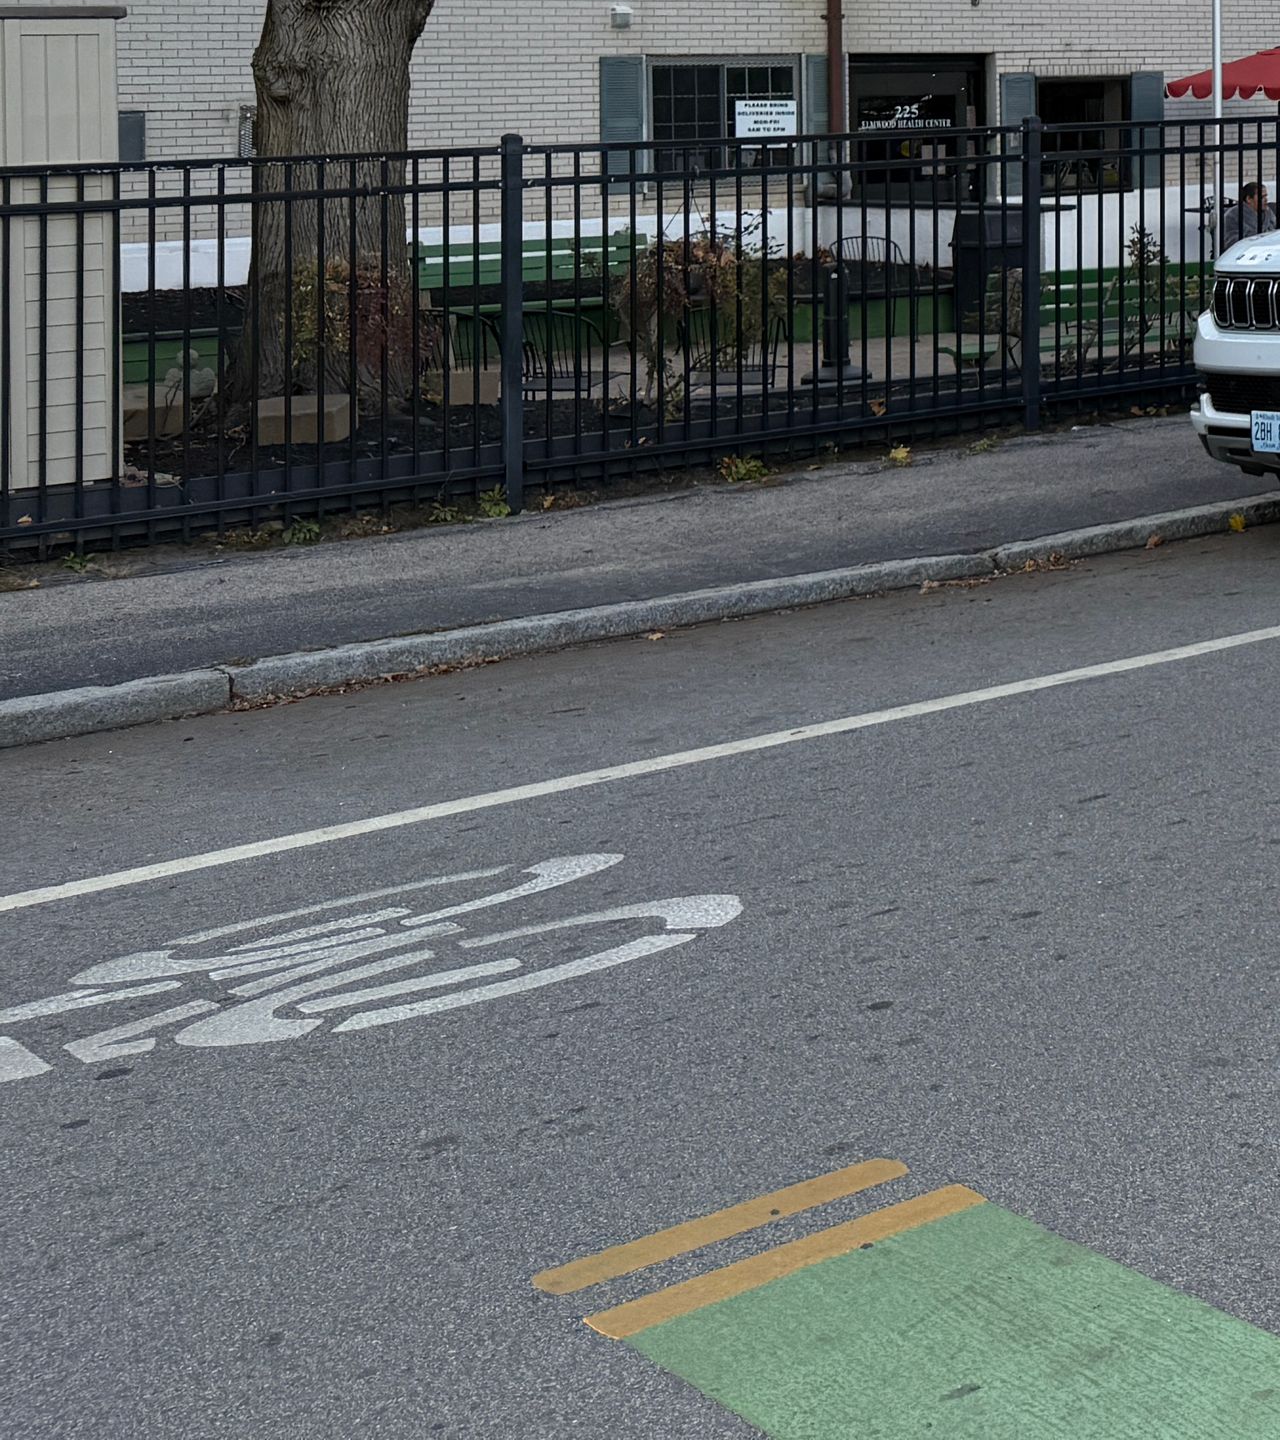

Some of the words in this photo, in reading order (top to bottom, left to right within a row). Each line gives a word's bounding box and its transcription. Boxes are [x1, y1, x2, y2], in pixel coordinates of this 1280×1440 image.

[894, 103, 919, 118] 225
[861, 120, 897, 129] ELMWOOD
[897, 120, 924, 128] HEALTH
[925, 119, 951, 127] CENTER
[1254, 421, 1272, 441] 2BH
